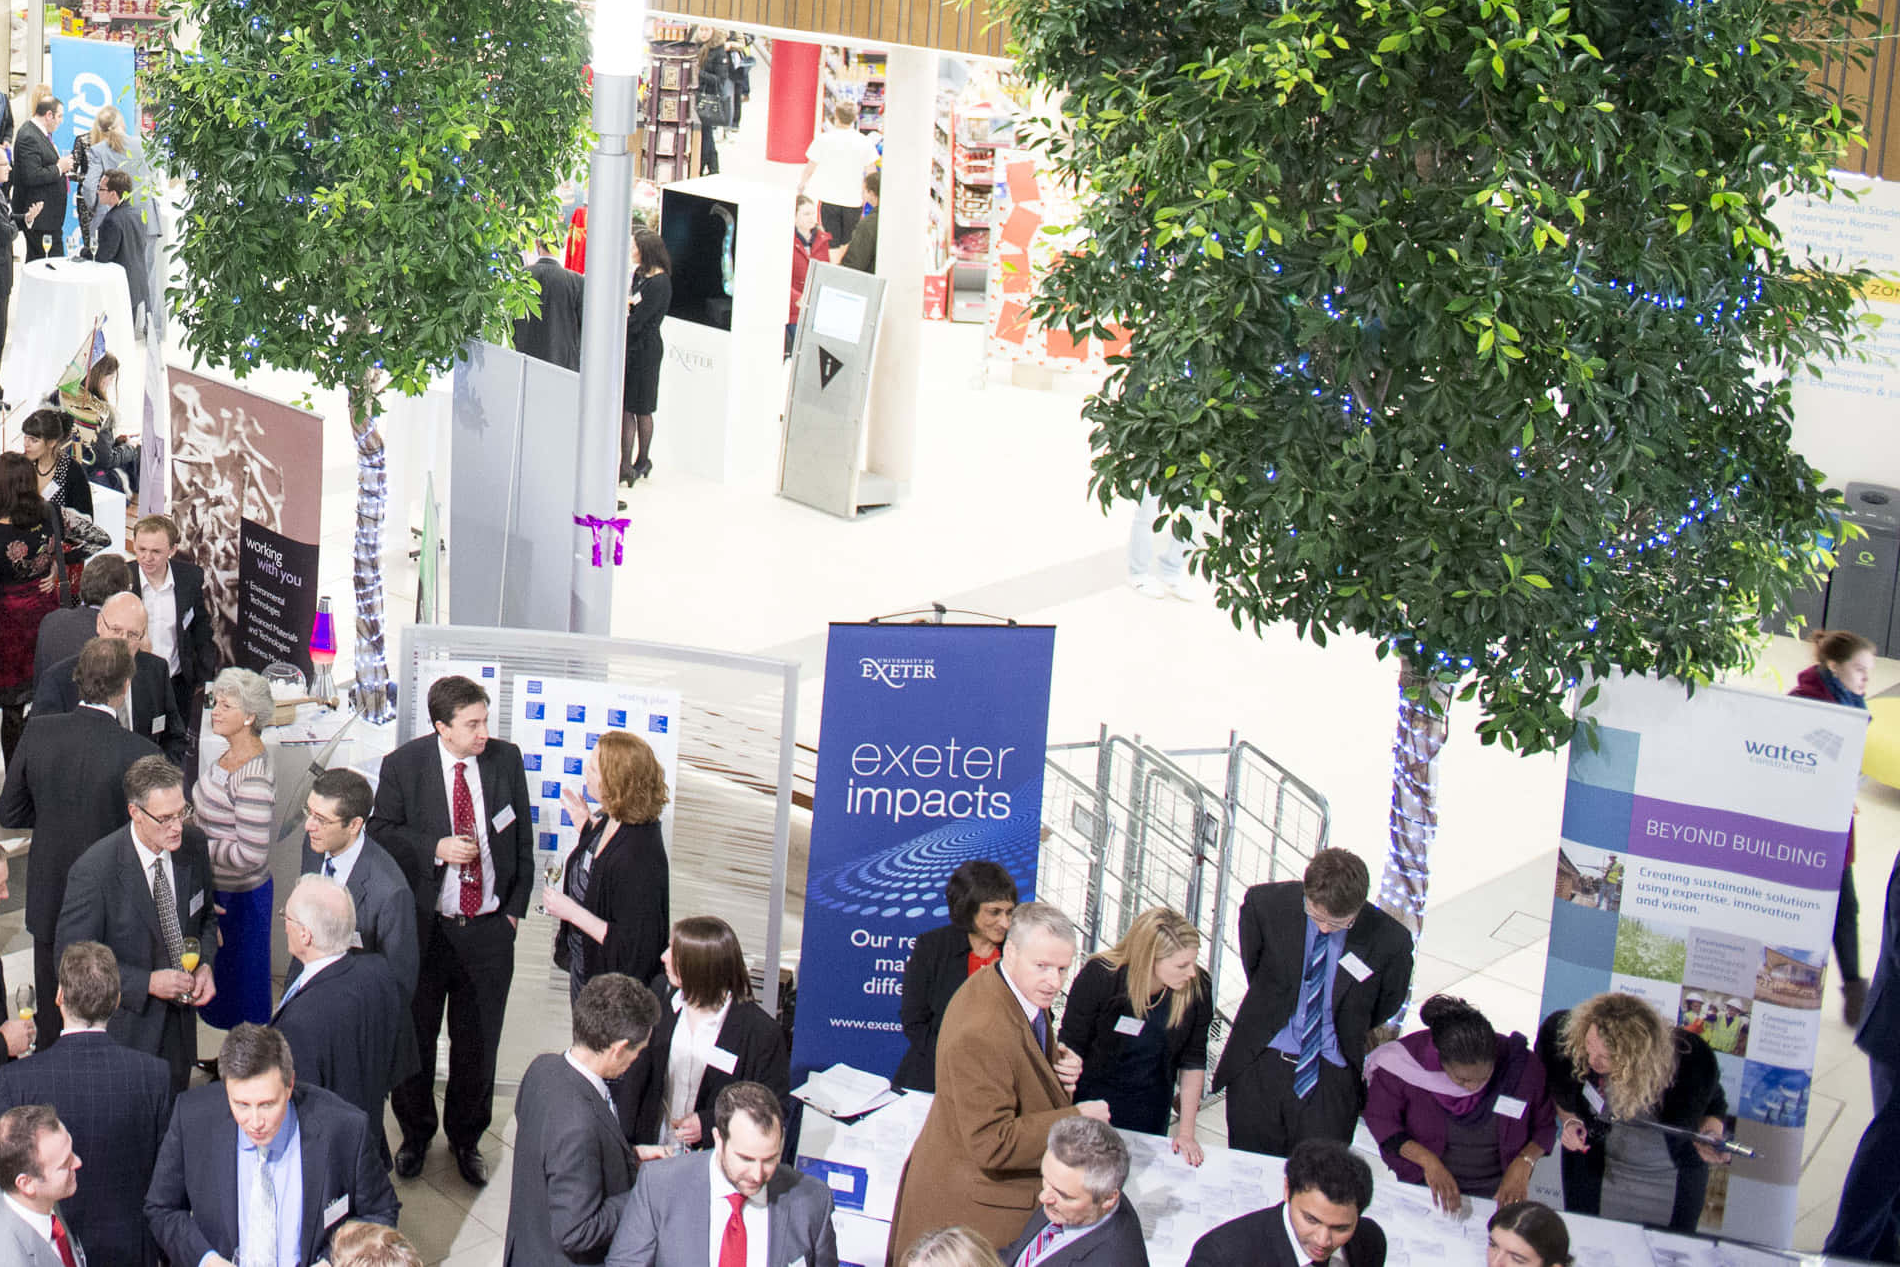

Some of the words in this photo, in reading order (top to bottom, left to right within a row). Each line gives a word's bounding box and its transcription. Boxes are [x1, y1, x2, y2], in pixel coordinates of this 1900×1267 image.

[245, 537, 283, 567] working
[257, 558, 278, 578] with
[280, 569, 302, 587] you
[860, 658, 937, 689] EXETER
[851, 737, 1016, 780] exeter
[1745, 739, 1818, 767] wates
[846, 778, 1012, 823] impacts
[1646, 818, 1727, 848] BEYOND
[1732, 834, 1828, 870] BUILDING
[1636, 895, 1659, 907] and
[1637, 882, 1669, 898] using
[1733, 897, 1801, 922] innovation
[1639, 866, 1690, 886] Creating
[1693, 876, 1762, 899] sustainable
[1765, 891, 1821, 911] solutions
[851, 929, 893, 948] Our
[898, 936, 916, 949] re
[875, 956, 911, 972] ma
[863, 977, 903, 995] diffe
[829, 1017, 903, 1032] www.exete
[1534, 1183, 1562, 1199] www.
